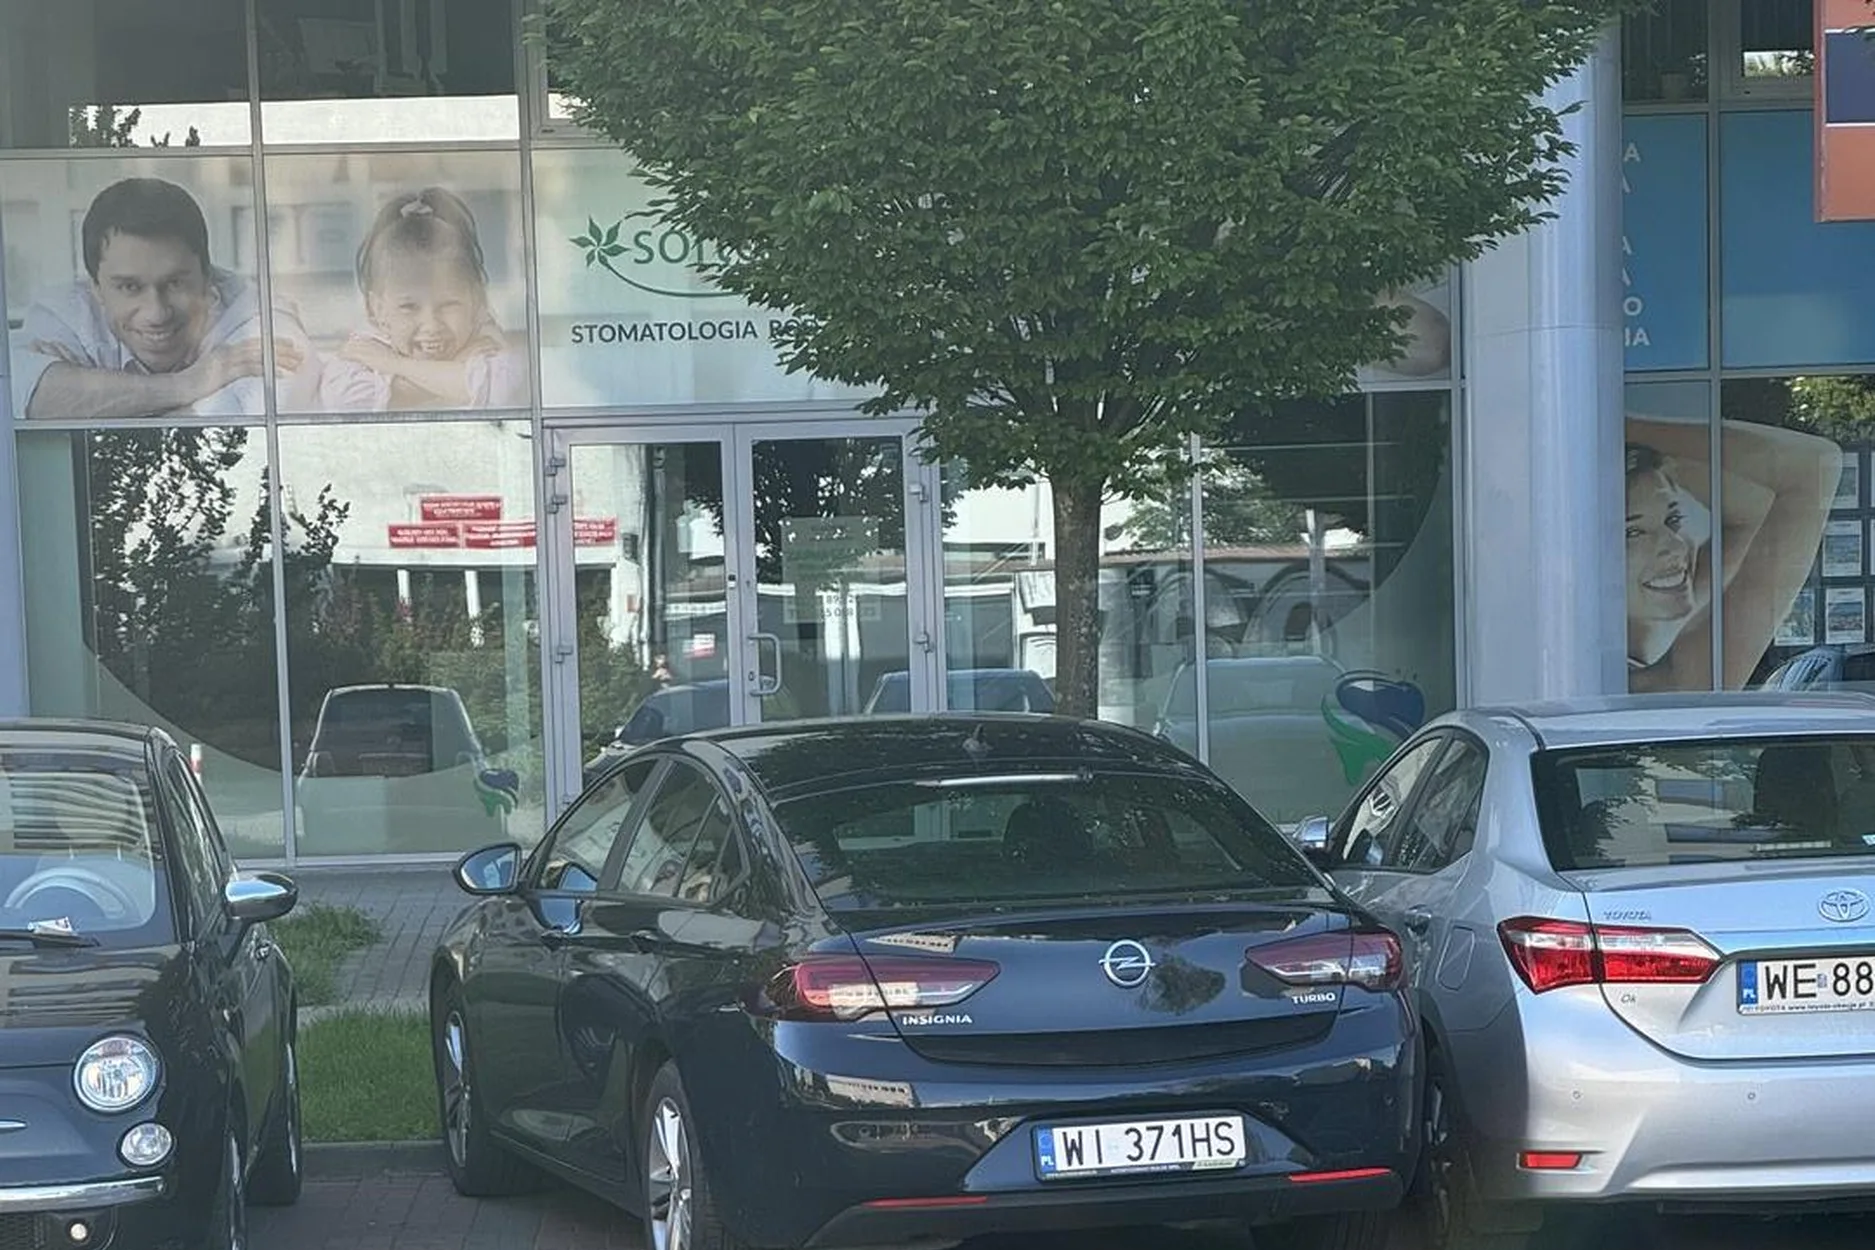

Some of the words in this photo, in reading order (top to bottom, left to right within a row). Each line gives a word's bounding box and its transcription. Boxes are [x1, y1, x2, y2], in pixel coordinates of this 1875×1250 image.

[571, 320, 758, 343] STOMATOLOGIA
[1765, 963, 1817, 1000] WE
[1292, 992, 1336, 1004] TURBO
[902, 1014, 973, 1026] INSIGNIA
[1062, 1128, 1103, 1167] WI
[1124, 1121, 1236, 1162] 371HS
[1041, 1156, 1054, 1166] PL
